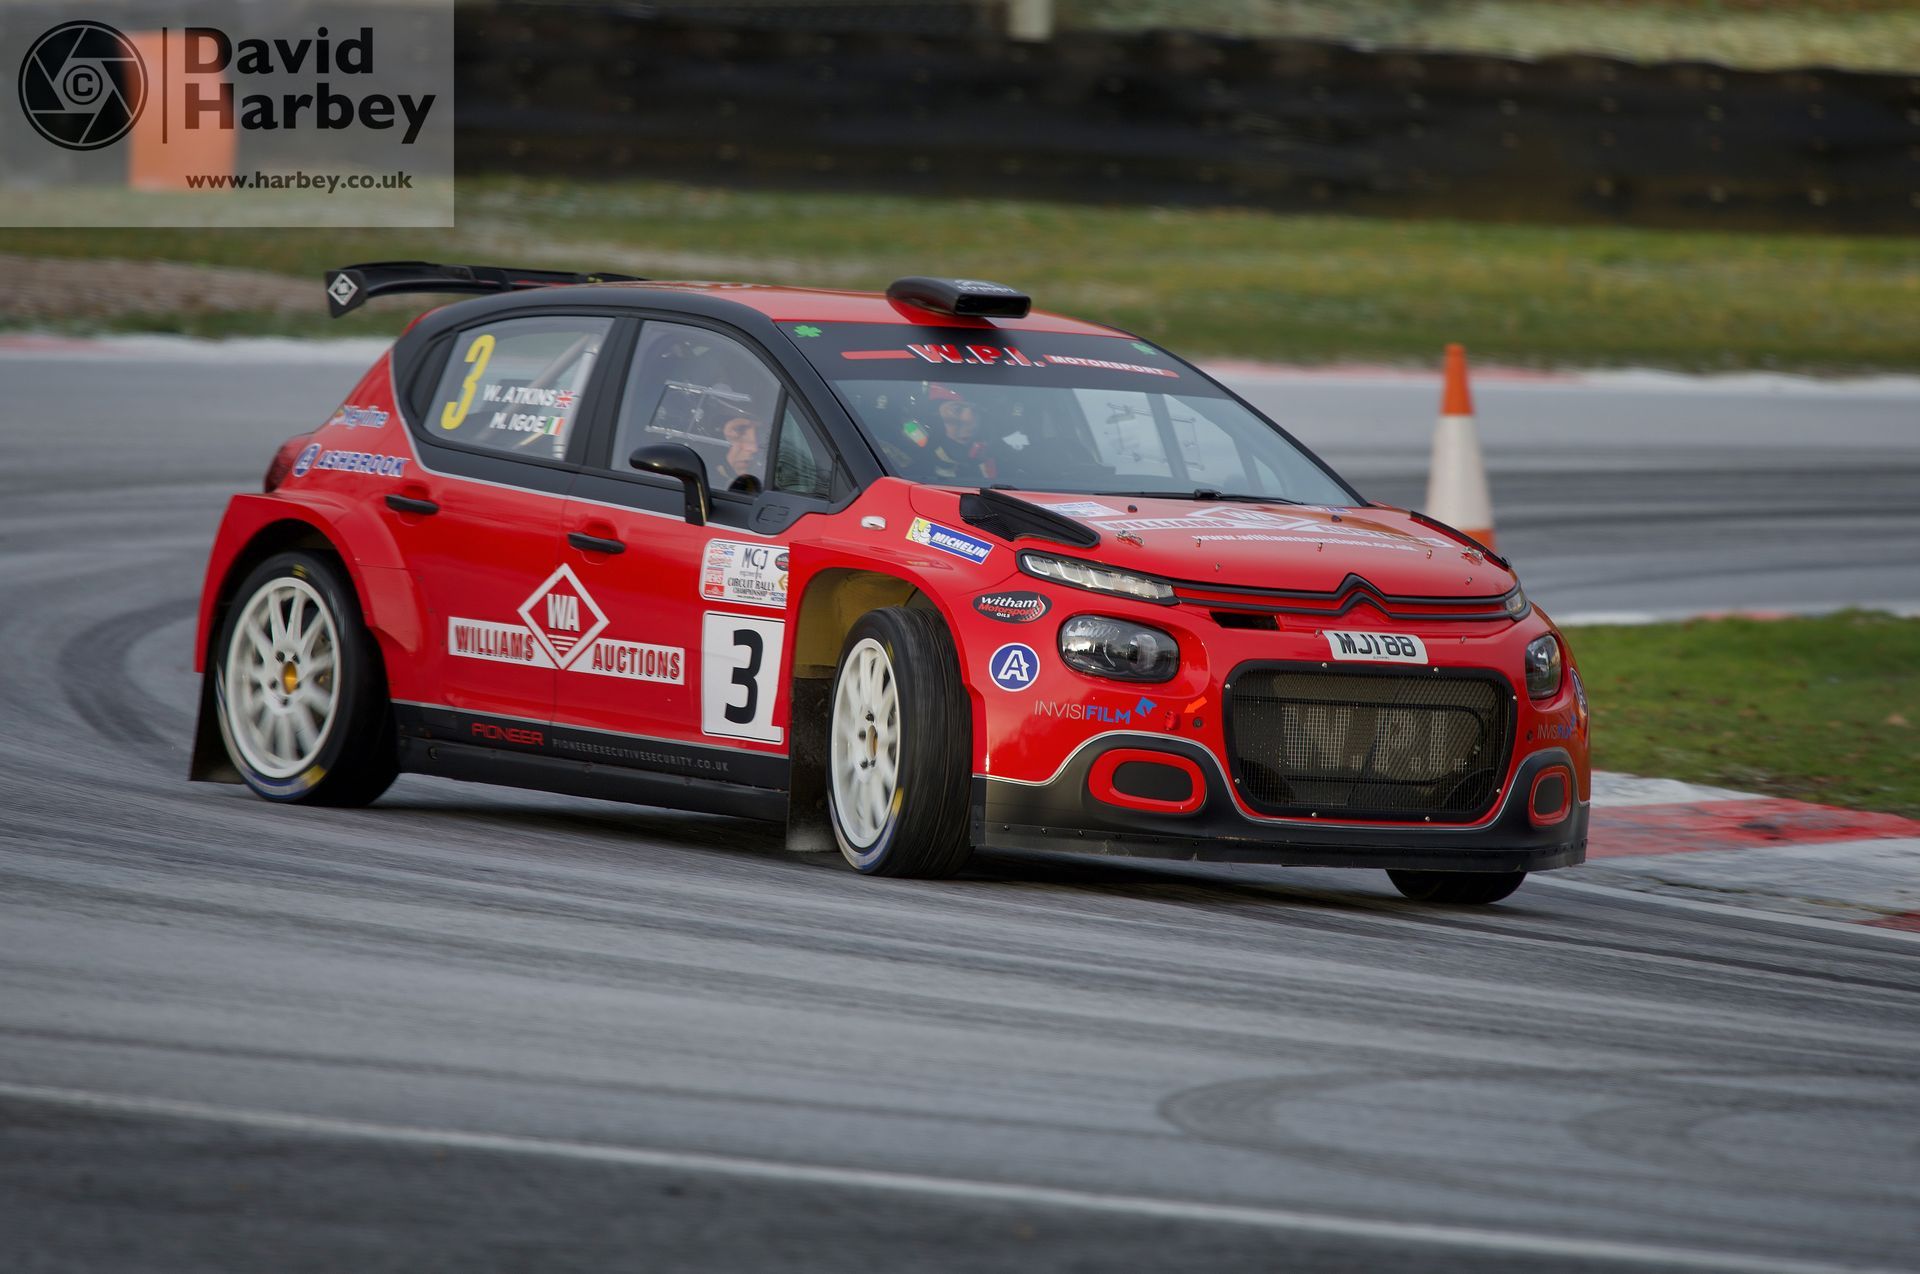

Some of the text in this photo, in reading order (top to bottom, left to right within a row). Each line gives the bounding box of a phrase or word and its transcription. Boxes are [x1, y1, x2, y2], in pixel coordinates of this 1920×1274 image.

[907, 343, 1046, 368] W.P.I.
[1052, 355, 1165, 376] MOTORSPORT
[440, 334, 496, 431] 3
[502, 386, 557, 407] ATKINS
[507, 413, 547, 433] IGOE
[313, 450, 411, 478] ASHBROOK
[932, 532, 989, 558] MICHELIN
[547, 593, 581, 632] WA
[980, 596, 1038, 608] witham
[454, 624, 536, 661] WILLIAMS
[592, 642, 681, 680] AUCTIONS
[724, 628, 764, 725] 3
[1033, 699, 1131, 725] INVISIFILM
[471, 722, 544, 747] PIONEER
[551, 737, 729, 773] PIONEEREXECUTIVESECURITY.CO.UK
